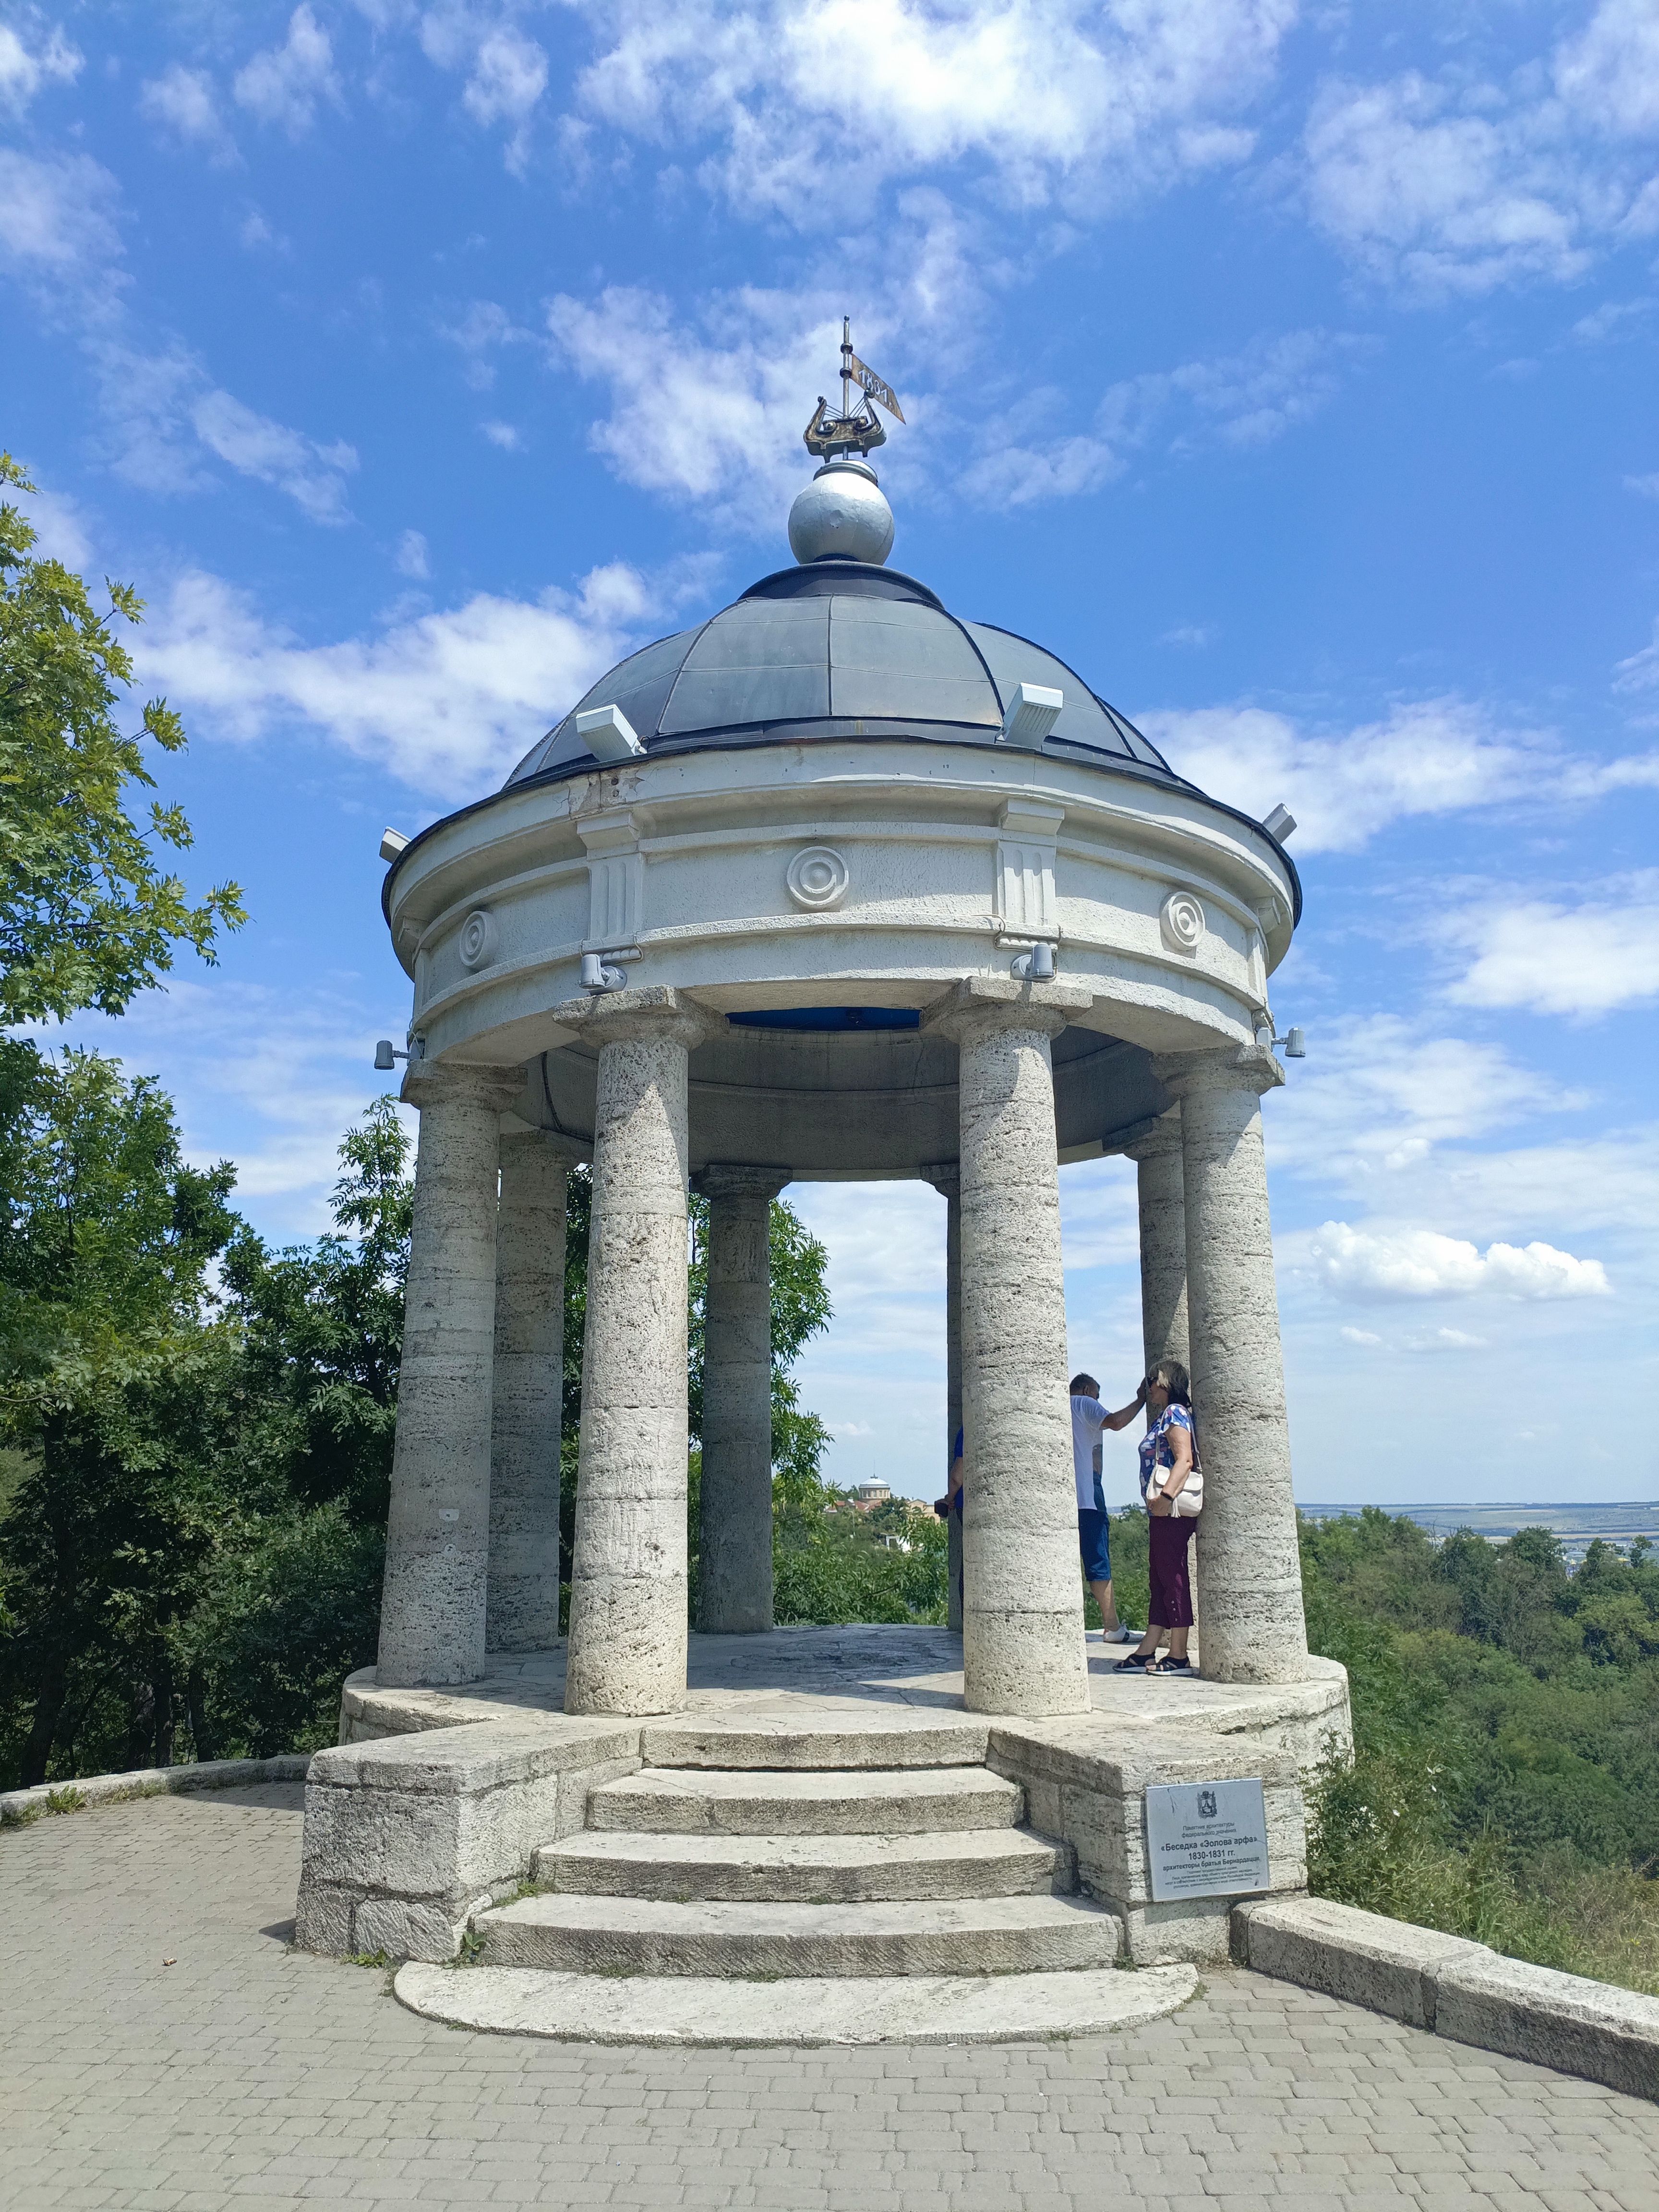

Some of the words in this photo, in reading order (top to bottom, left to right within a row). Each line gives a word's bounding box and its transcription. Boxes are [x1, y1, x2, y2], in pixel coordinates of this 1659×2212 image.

[858, 369, 887, 403] 1831
[1206, 1822, 1235, 1830] архитектуры
[1161, 1842, 1198, 1851] «Беседка
[1200, 1839, 1232, 1848] «Эолова
[1234, 1836, 1258, 1846] арфа»
[1188, 1850, 1225, 1860] 1830-1831
[1163, 1863, 1200, 1872] архитекторы
[1222, 1857, 1260, 1865] Бернардацци
